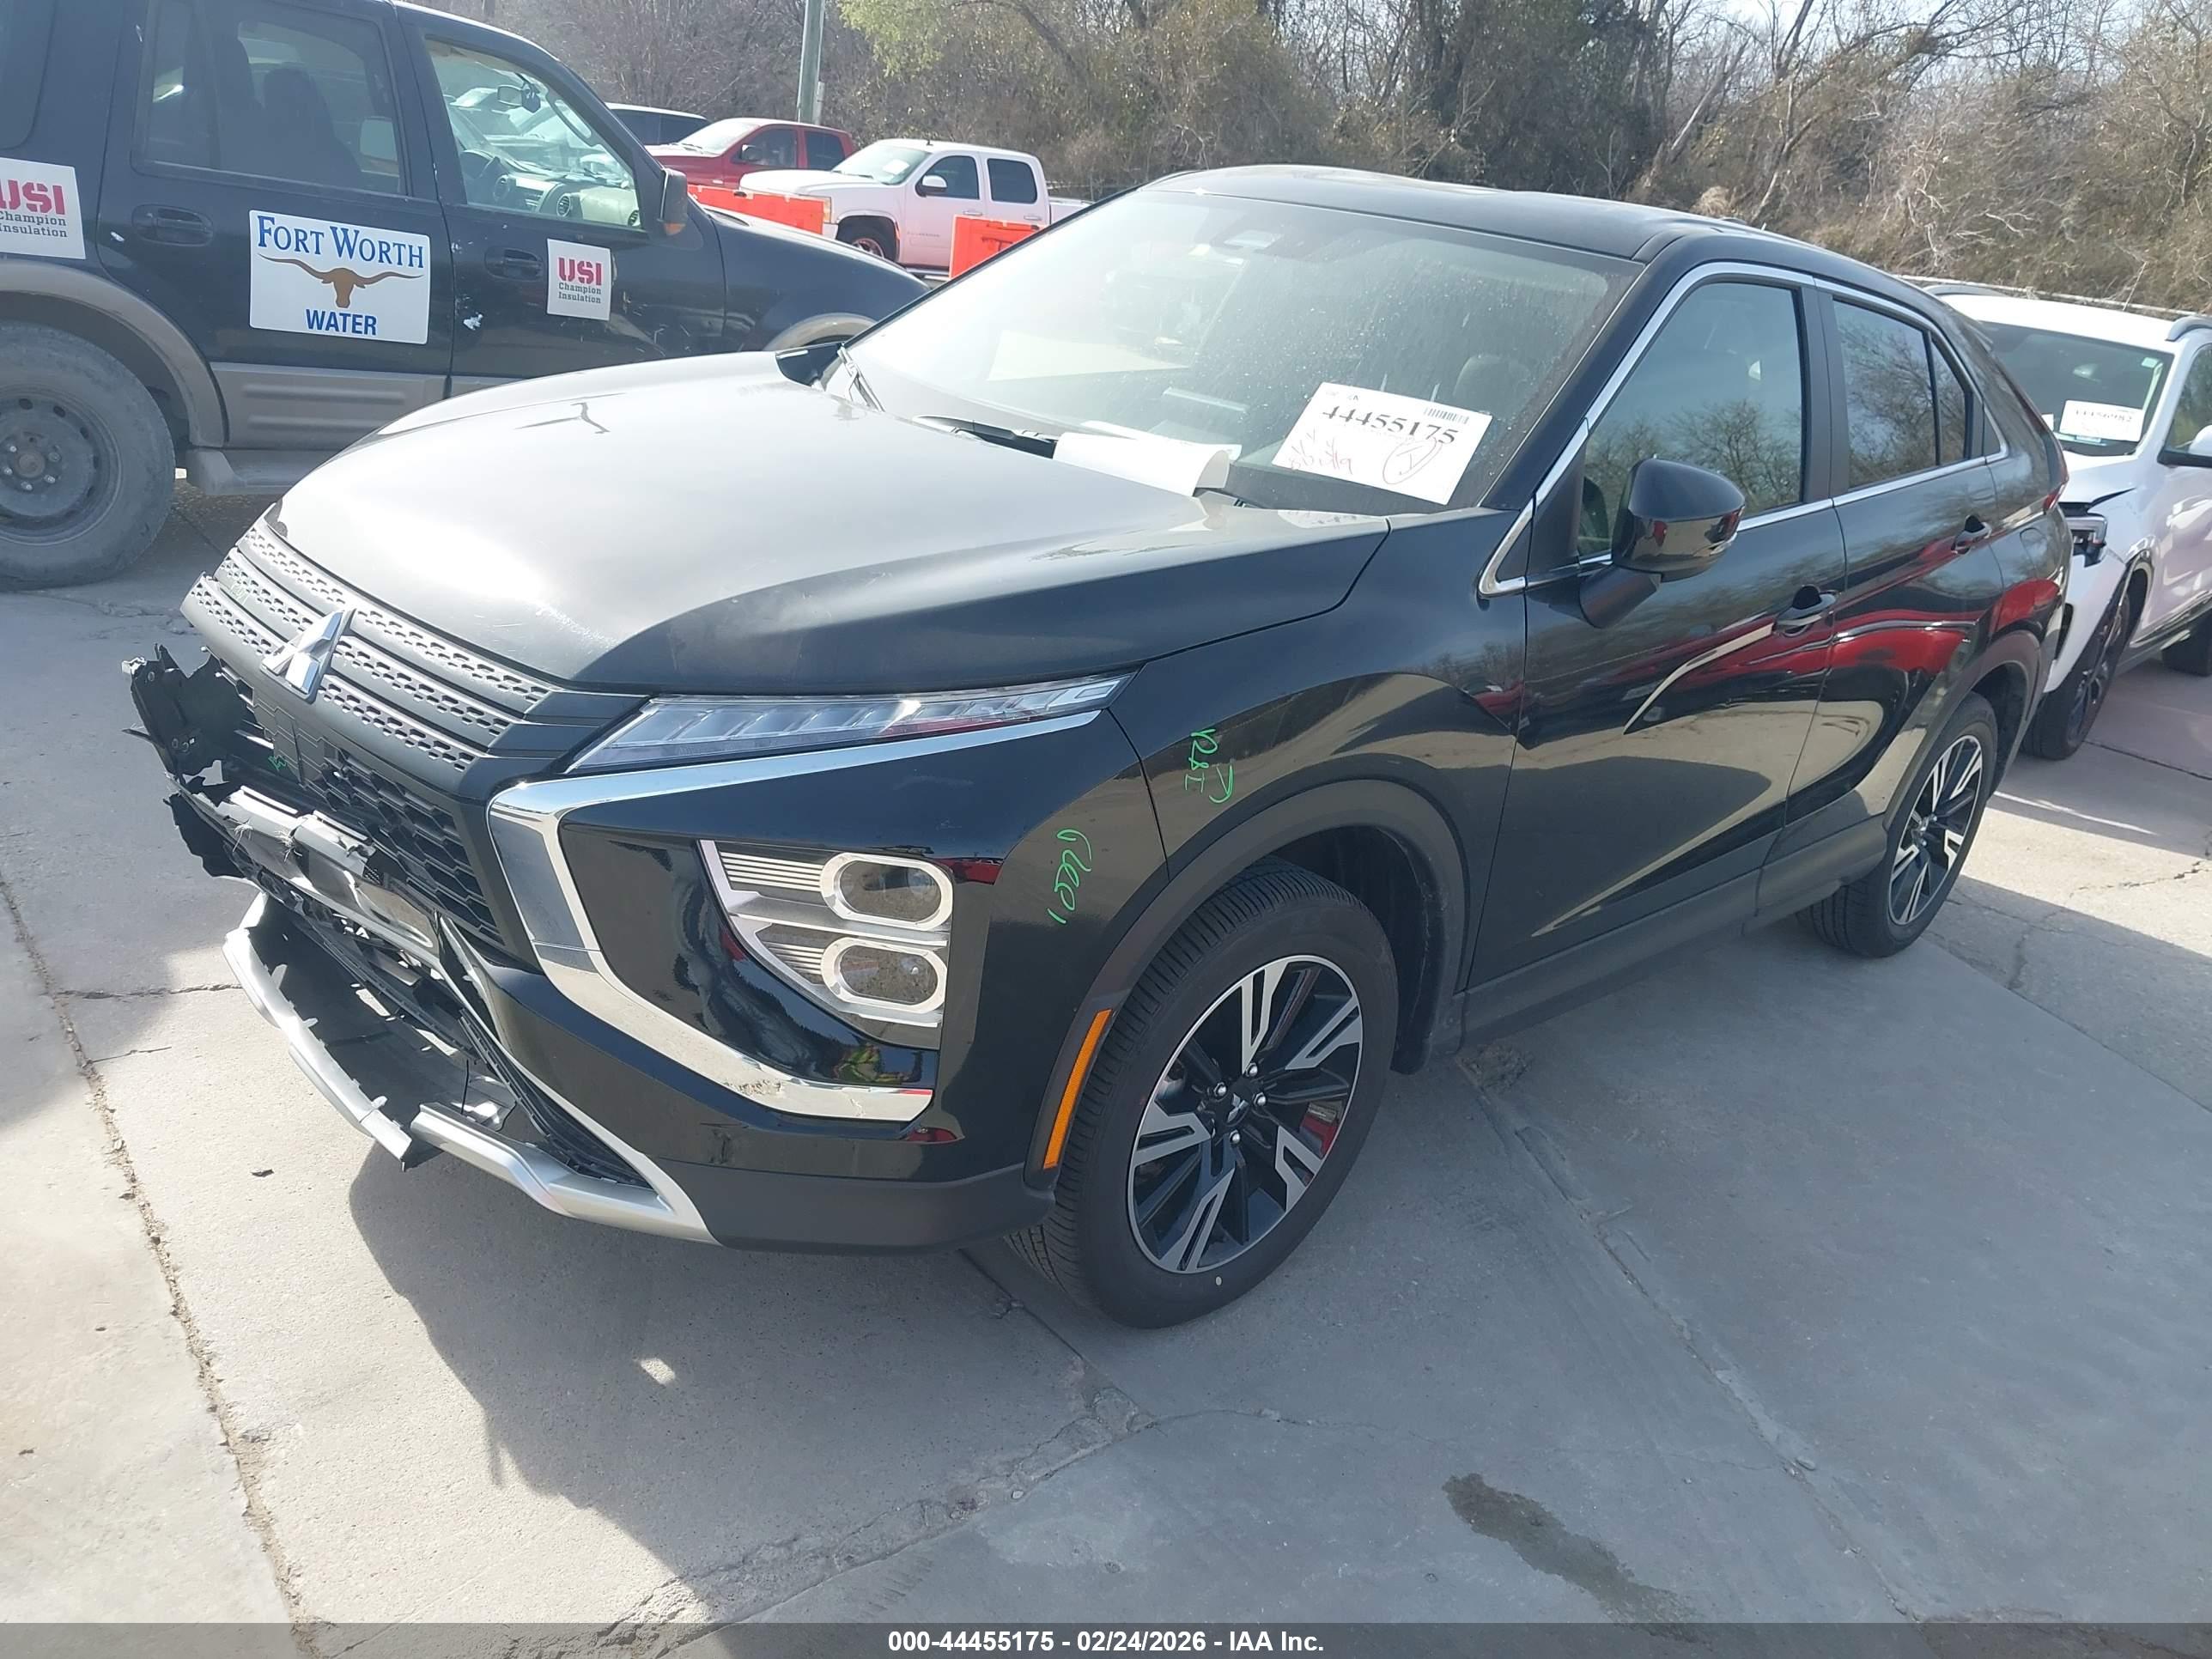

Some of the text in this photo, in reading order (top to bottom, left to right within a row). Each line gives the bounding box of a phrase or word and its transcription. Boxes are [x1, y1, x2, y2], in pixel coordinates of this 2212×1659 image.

[0, 179, 65, 216] USI
[257, 215, 424, 268] FORT WORTH
[558, 257, 602, 286] USI
[558, 282, 602, 295] Champion
[558, 291, 602, 304] Insulation
[306, 308, 377, 336] WATER
[1322, 405, 1459, 445] 44455175
